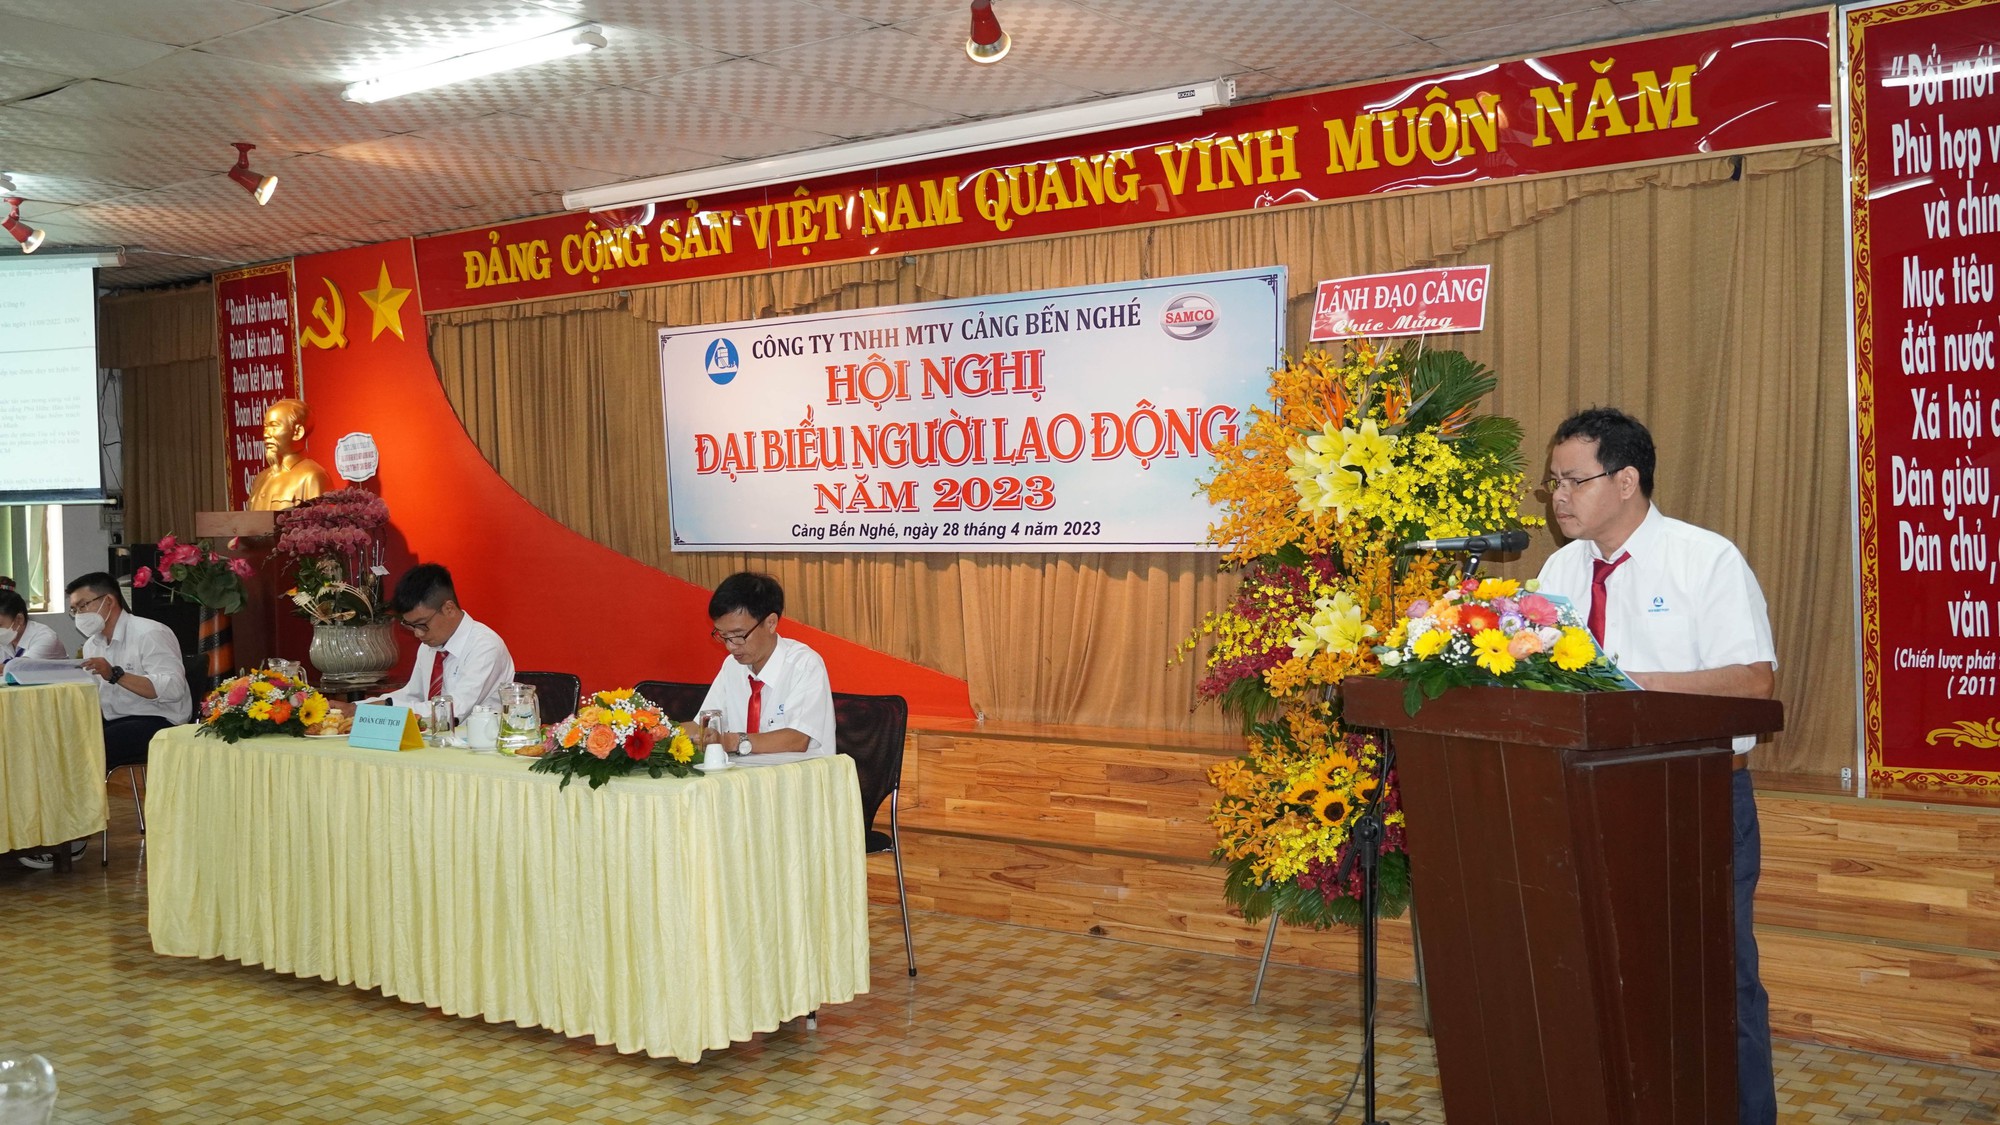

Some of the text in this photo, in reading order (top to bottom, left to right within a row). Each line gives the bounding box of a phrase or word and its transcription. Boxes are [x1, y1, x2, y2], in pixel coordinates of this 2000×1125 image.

[1952, 44, 1994, 101] mới
[1891, 118, 1933, 177] Phù
[1938, 113, 1982, 179] hợp
[463, 57, 1700, 290] ĐẢNG CỘNG SẢN VIỆT NAM QUANG VINH MUÔN NĂM
[1923, 187, 1951, 239] và
[1317, 271, 1483, 315] LÃNH ĐẠO CẢNG
[1902, 252, 1994, 318] Mục tiêu
[752, 297, 1141, 360] CÔNG TY TNHH MTV CẢNG BẾN NGHÉ
[1165, 309, 1215, 324] SAMCO
[1332, 317, 1384, 335] Chúc
[1901, 319, 1995, 376] đất nước
[825, 349, 1046, 410] HỘI NGHỊ
[694, 398, 1241, 483] ĐẠI BIỂU NGƯỜI LAO ĐỘNG
[1910, 387, 1941, 441] Xã
[1947, 383, 1982, 450] hội
[813, 473, 1056, 514] NĂM 2023
[1891, 455, 1935, 508] Dân
[791, 520, 1102, 541] Cảng Bến Nghé, ngày 28 tháng 4 năm 2023
[1898, 520, 1943, 573] Dân
[1947, 590, 1990, 639] văn
[1937, 648, 1964, 673] lược
[1965, 648, 1997, 675] phát
